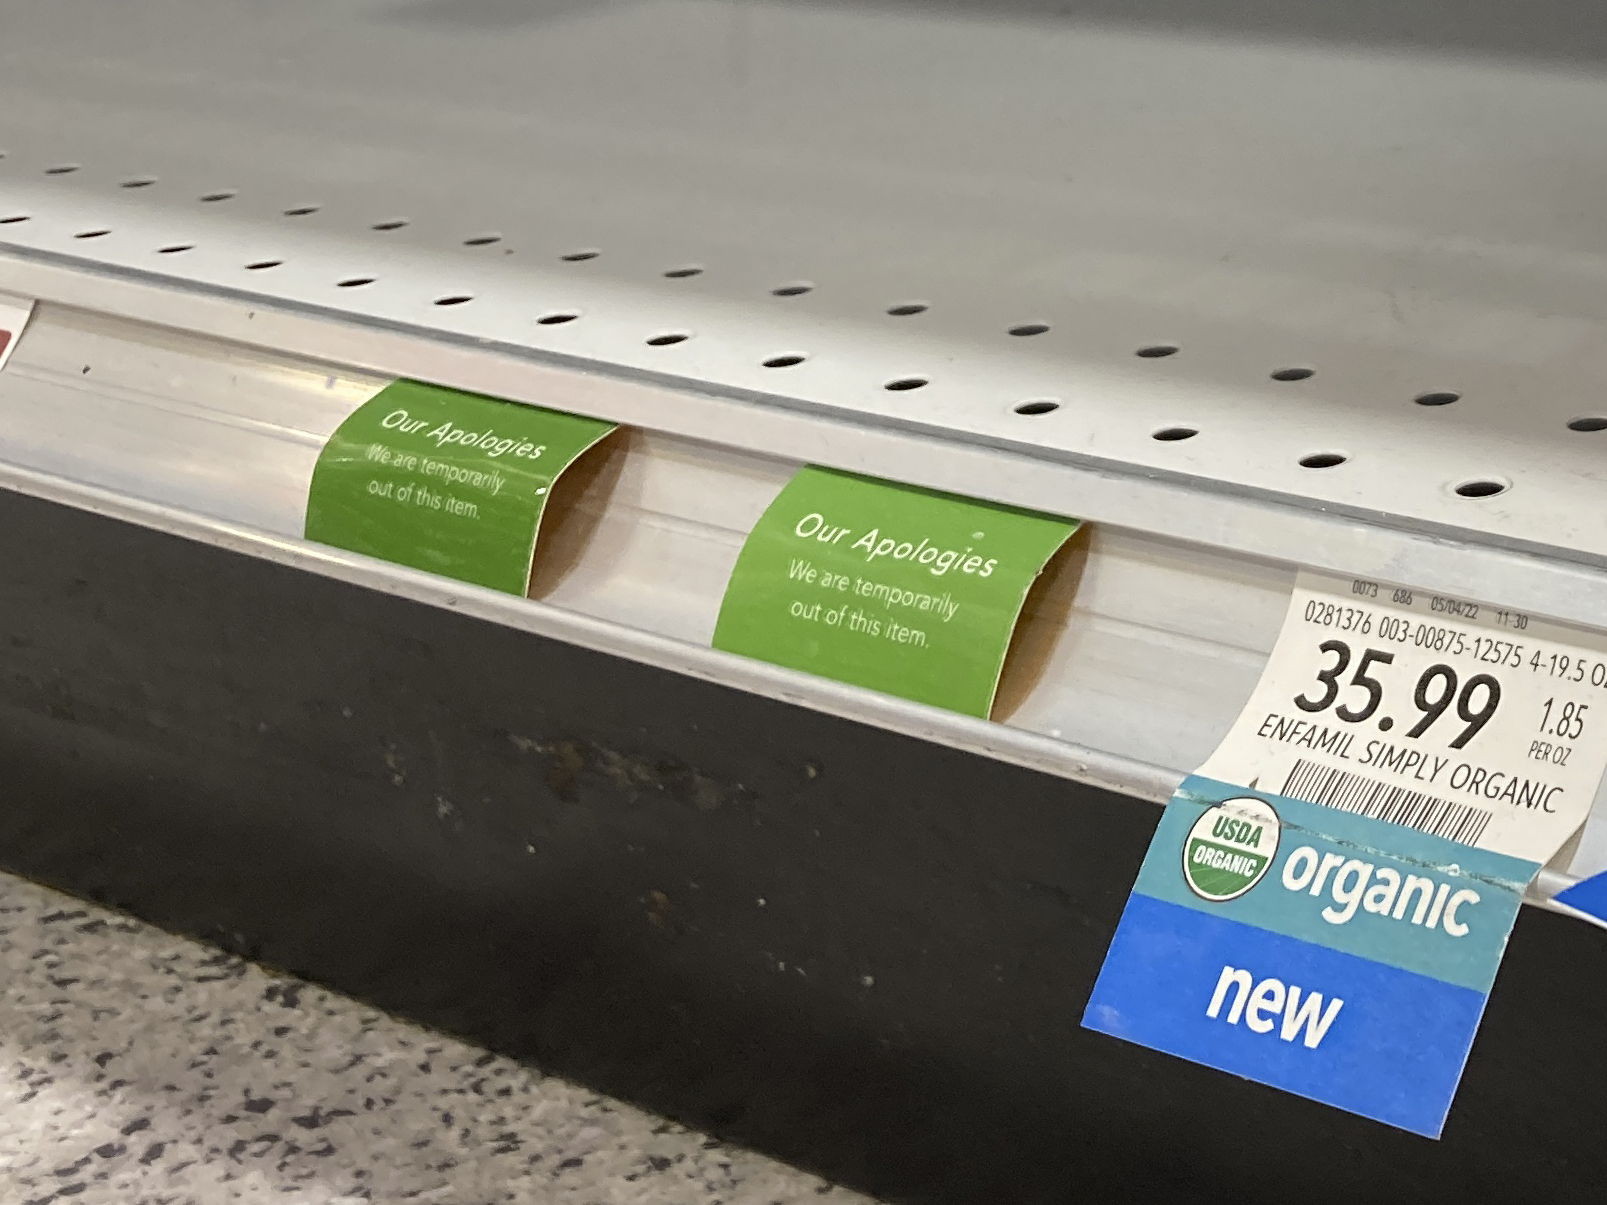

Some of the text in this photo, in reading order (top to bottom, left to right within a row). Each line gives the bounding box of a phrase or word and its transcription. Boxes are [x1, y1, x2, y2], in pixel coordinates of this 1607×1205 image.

[381, 409, 547, 460] Our Apologies
[367, 443, 506, 495] We are temporarily
[368, 479, 480, 520] out of this item.
[795, 513, 998, 578] Our Apologies
[789, 558, 960, 623] We are temporarily
[1352, 580, 1378, 597] 0073
[1392, 588, 1412, 605] 686
[1430, 596, 1479, 620] 05/04/22
[790, 600, 930, 648] out of this item.
[1305, 600, 1371, 634] 0281376
[1378, 616, 1524, 668] 003-00875-12575
[1529, 650, 1585, 683] 4-19.5
[1293, 640, 1501, 750] 35.99
[1538, 697, 1588, 741] 1.85
[1257, 713, 1564, 815] ENFAMIL SIMPLY ORGANIC
[1527, 739, 1572, 767] PER OZ
[1212, 815, 1263, 848] USDA
[1193, 845, 1257, 878] ORGANIC
[1281, 846, 1481, 938] organic
[1205, 965, 1344, 1050] new
